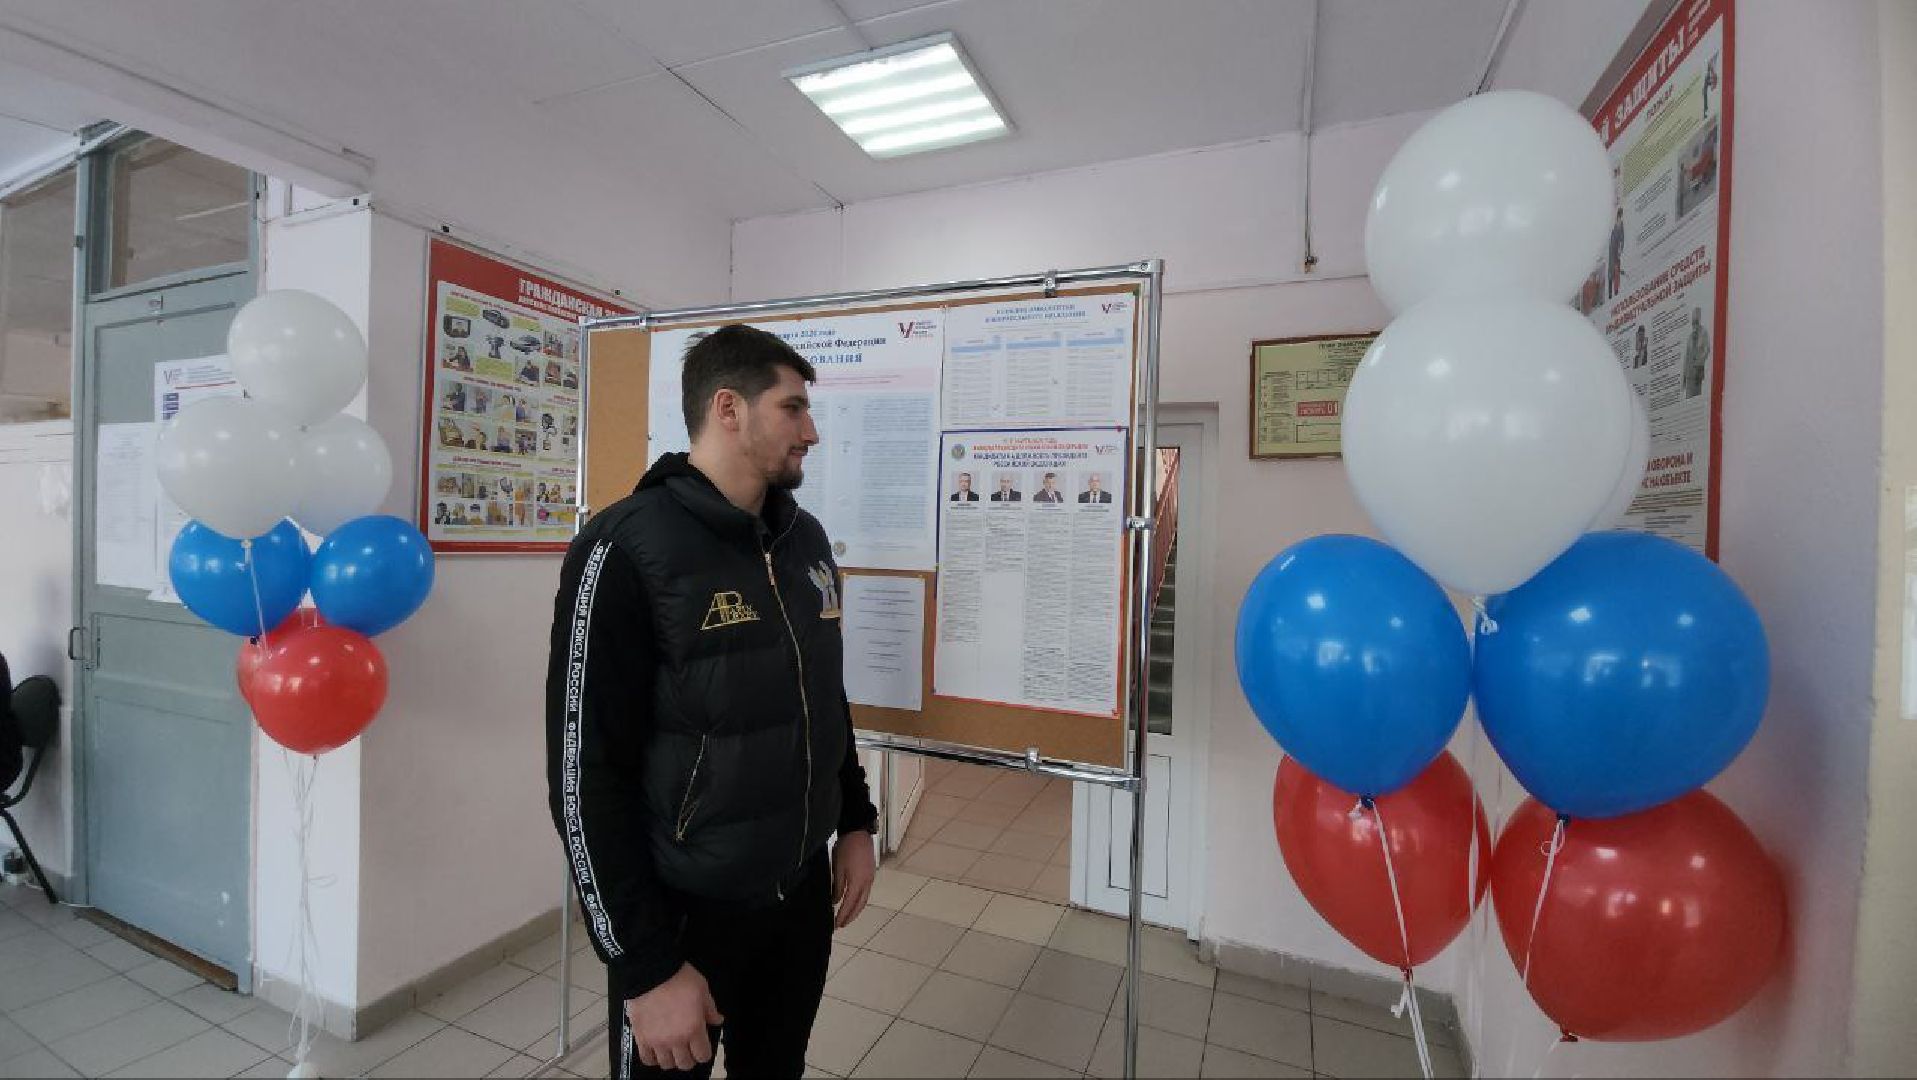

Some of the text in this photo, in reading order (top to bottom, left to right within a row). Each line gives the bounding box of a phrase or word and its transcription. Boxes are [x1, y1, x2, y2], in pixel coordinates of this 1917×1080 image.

[1614, 24, 1685, 129] ЗАЩИТЫ
[809, 353, 863, 364] ОВАНИЯ
[835, 336, 887, 349] Федерации
[1327, 401, 1338, 414] 01
[578, 545, 605, 617] ФЕДЕРАЦИЯ
[572, 618, 585, 659] БОКСА
[569, 662, 582, 712] РОССИИ
[566, 721, 577, 793] ФЕДЕРАЦИЯ
[566, 795, 578, 833] БОКСА
[571, 836, 590, 884] РОССИИ
